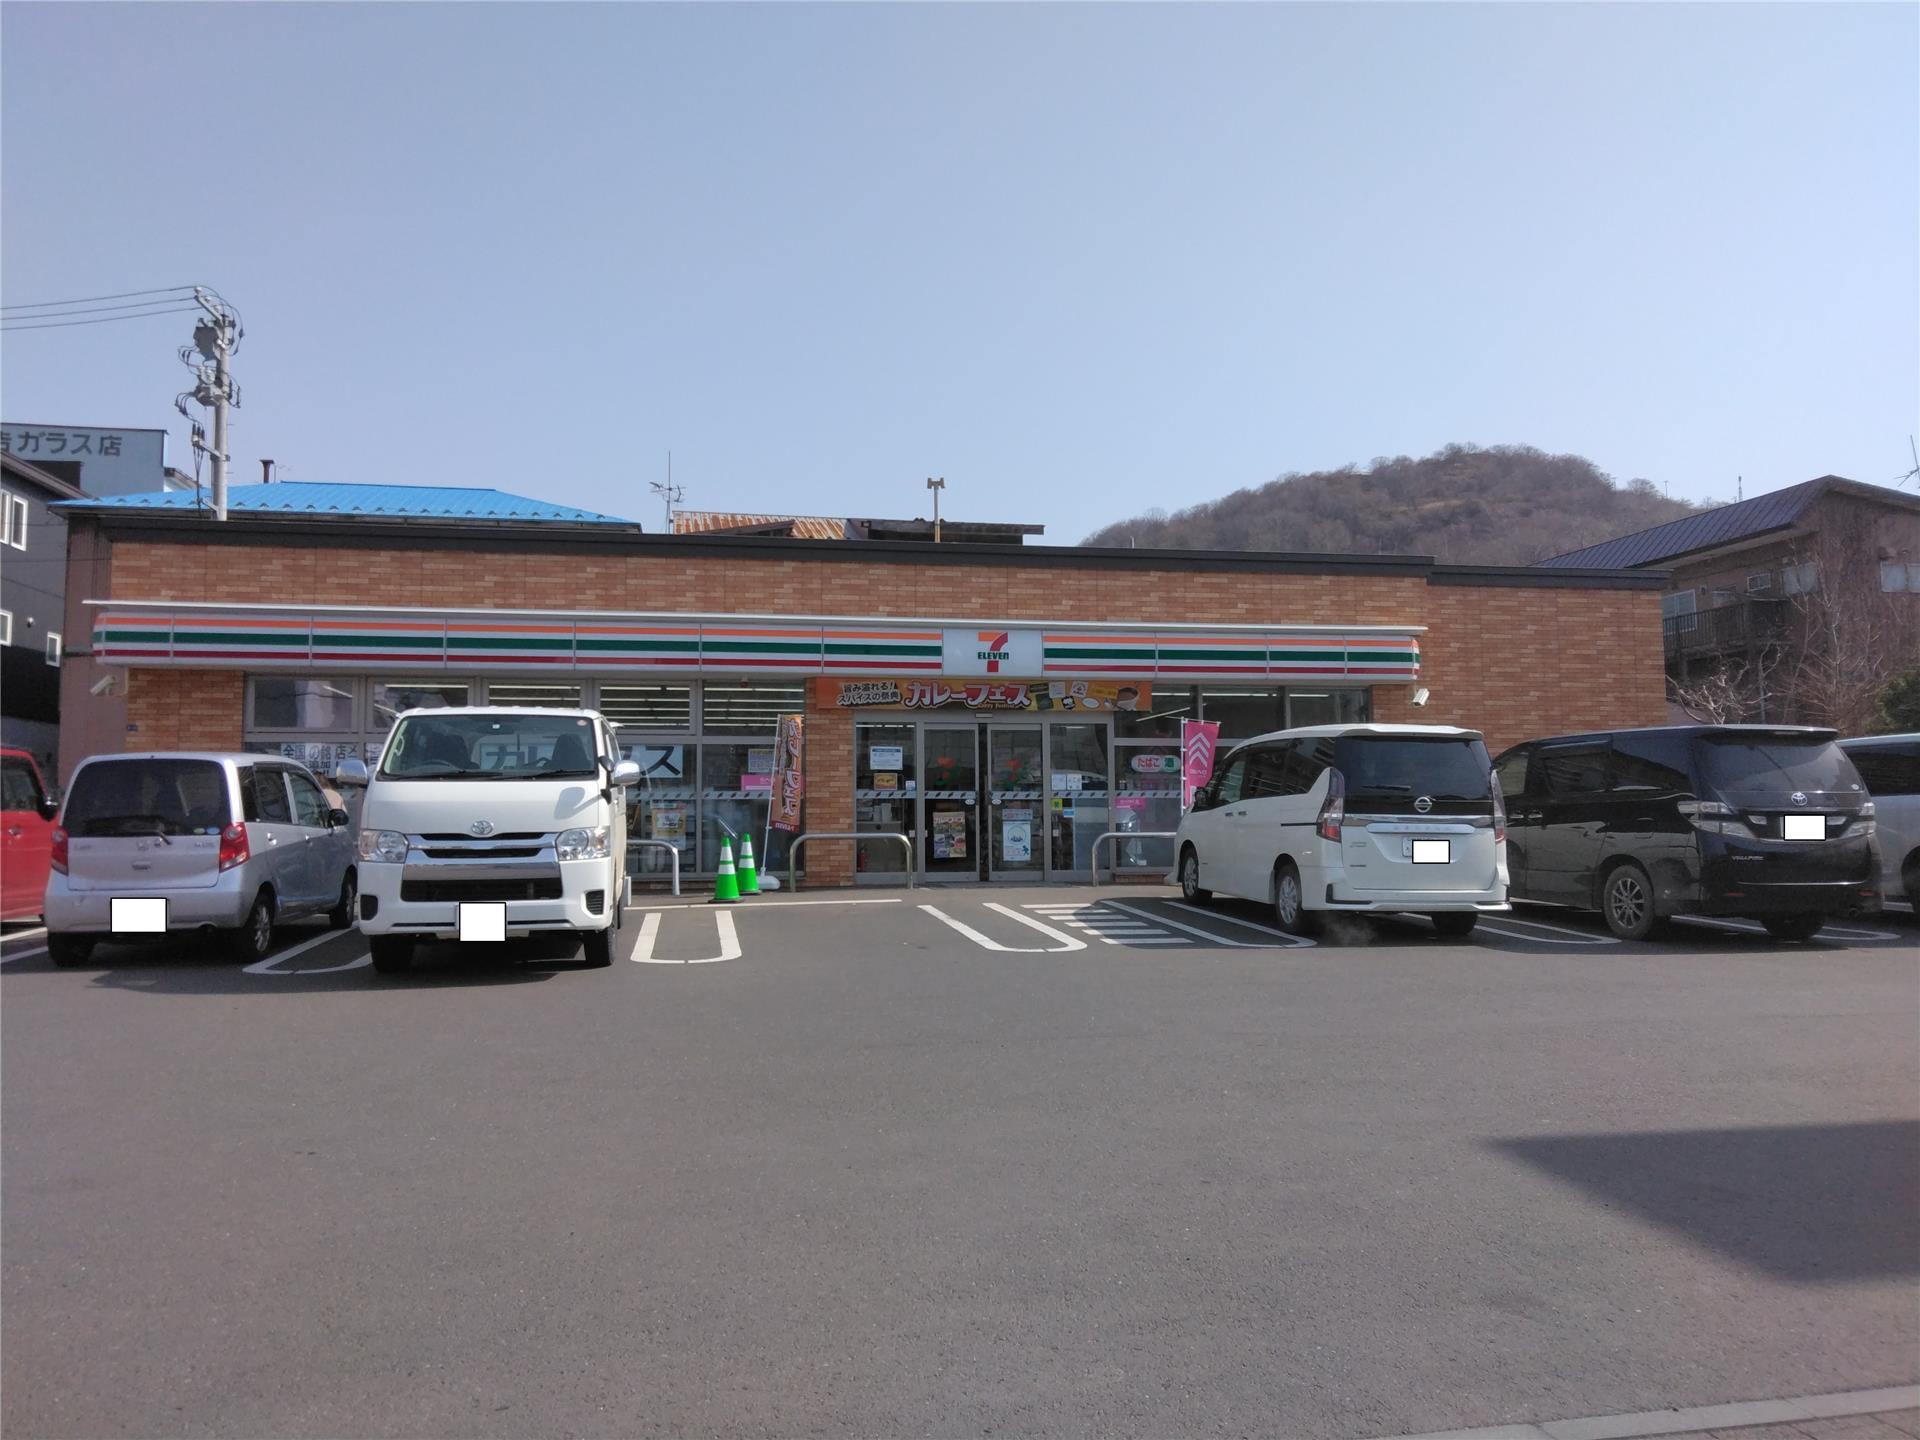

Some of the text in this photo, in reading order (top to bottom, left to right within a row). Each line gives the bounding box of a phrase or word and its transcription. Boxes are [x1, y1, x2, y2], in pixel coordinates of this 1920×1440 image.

[905, 682, 1031, 706] カレーフェス
